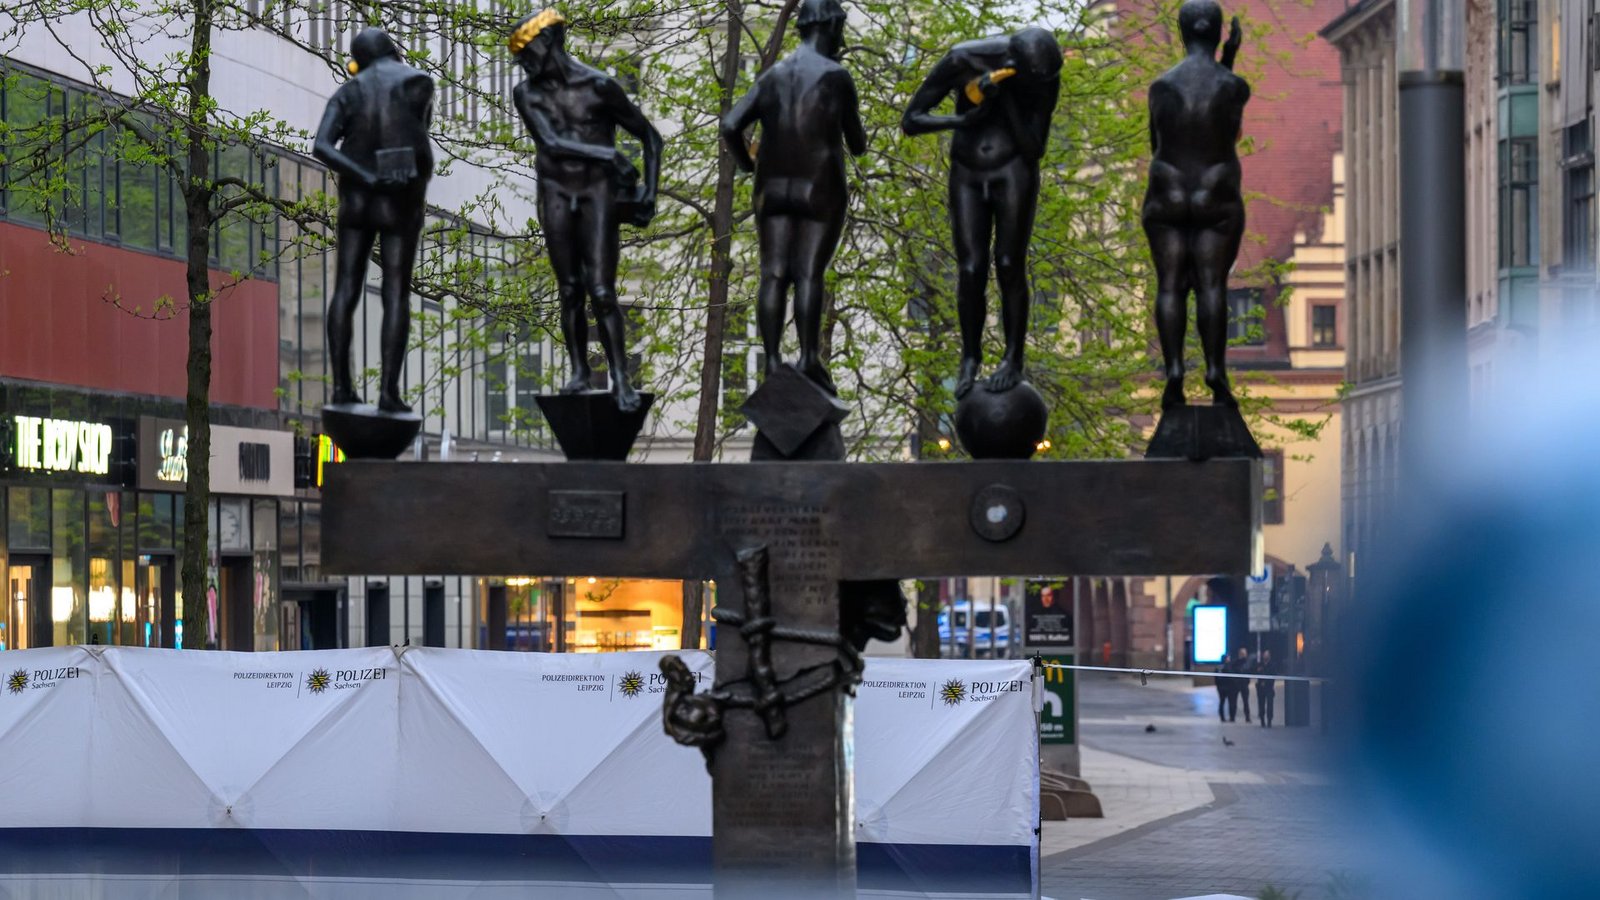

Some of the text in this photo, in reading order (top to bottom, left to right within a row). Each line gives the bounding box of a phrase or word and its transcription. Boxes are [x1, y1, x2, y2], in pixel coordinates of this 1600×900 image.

[15, 416, 42, 468] THE
[43, 418, 80, 471] BODY
[78, 421, 112, 474] SHOP
[33, 667, 80, 682] POLIZEI
[233, 672, 294, 680] POLIZEIDIREKTION
[335, 668, 387, 682] POLIZEI
[541, 674, 606, 682] POLIZEIDIREKTION
[649, 671, 702, 685] POEI
[31, 681, 56, 690] Sachsen
[266, 681, 293, 689] LEIPZIG
[334, 682, 361, 690] Sachsen
[577, 684, 604, 692] LEIPZIG
[863, 681, 927, 689] POLIZEIDIREKTION
[971, 680, 1024, 694] POLIZEI
[648, 685, 667, 694] Sach
[898, 691, 926, 699] LEIPZIG
[969, 694, 998, 702] Sachsen
